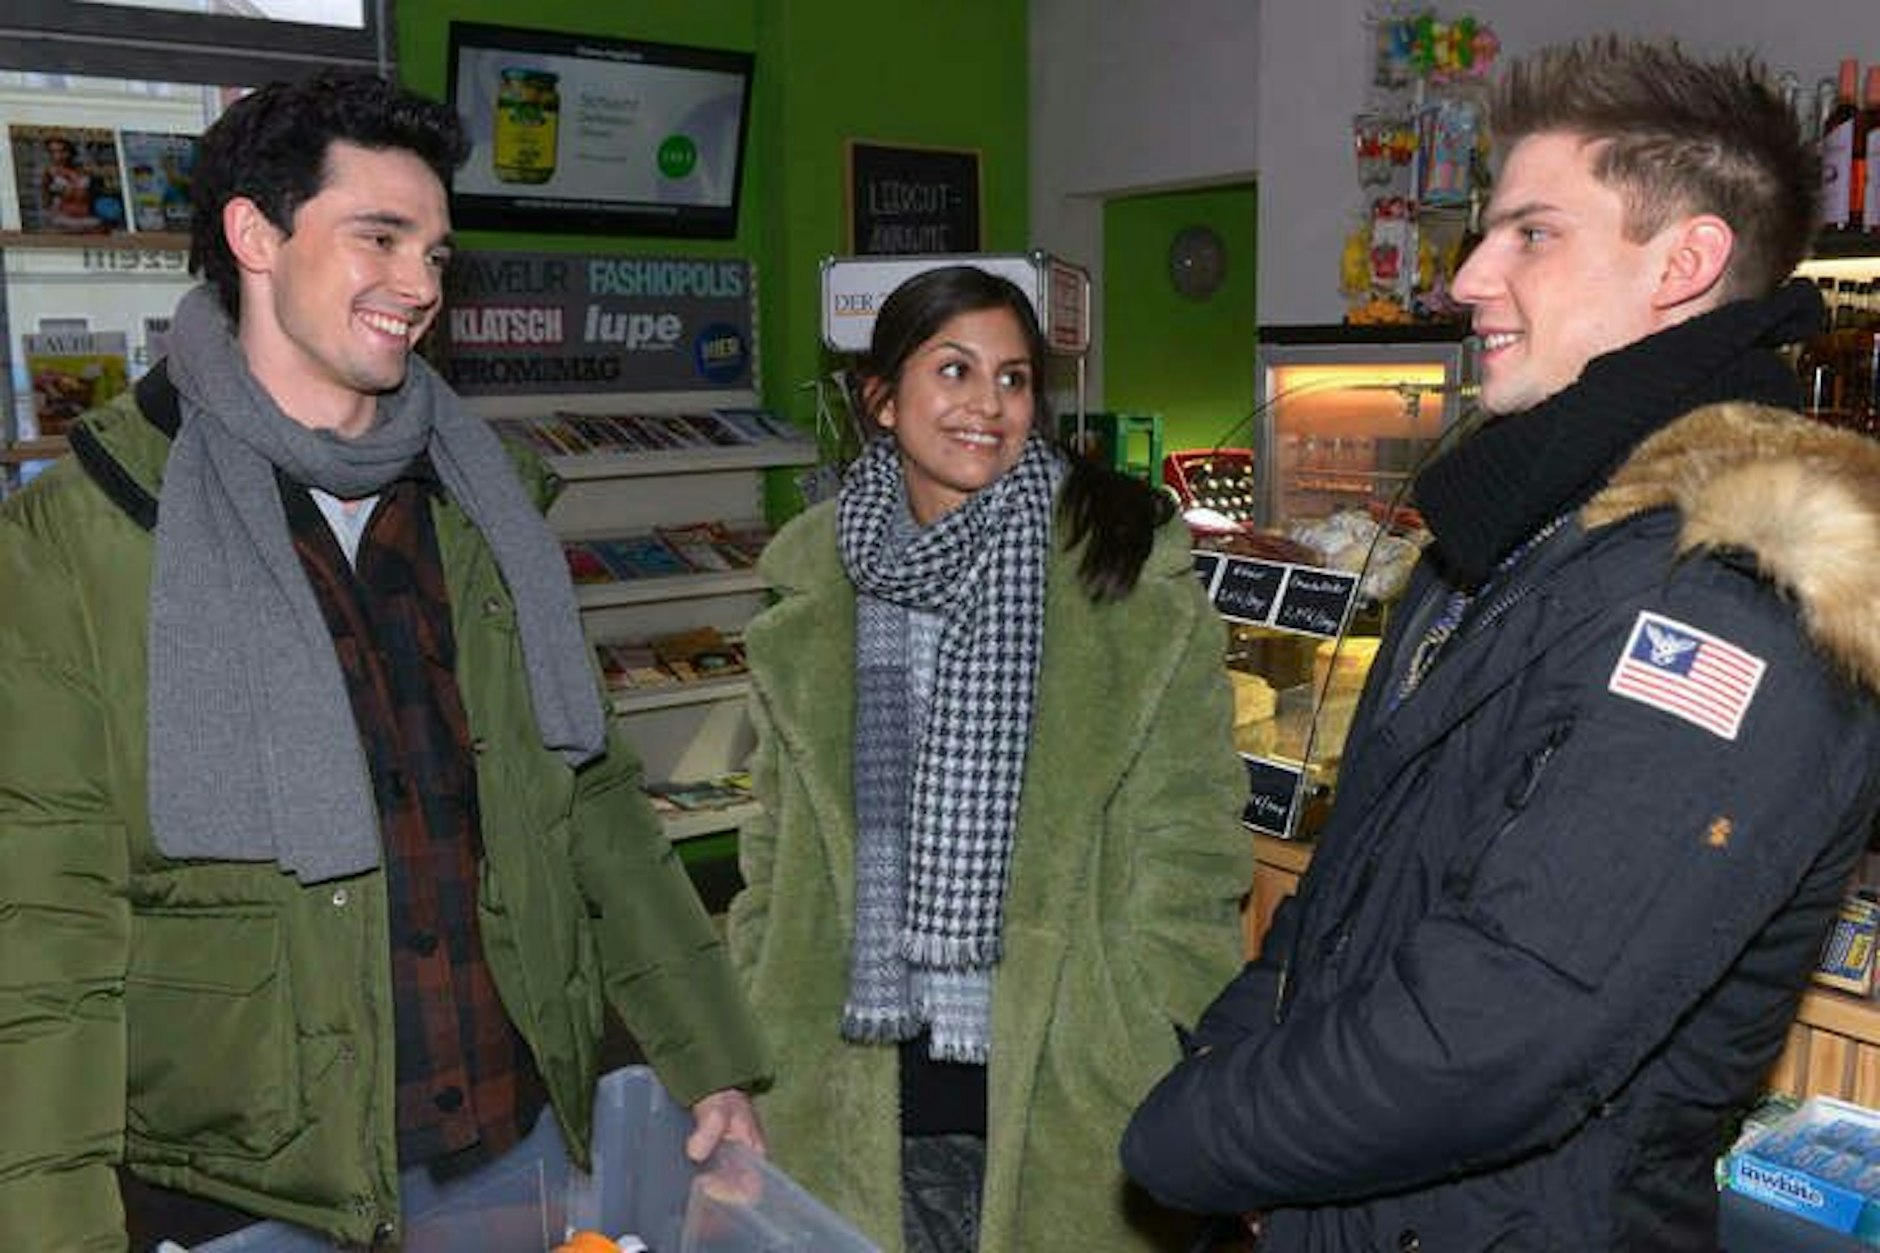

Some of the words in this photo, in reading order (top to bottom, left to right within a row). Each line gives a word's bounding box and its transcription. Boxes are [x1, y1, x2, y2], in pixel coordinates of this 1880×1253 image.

[588, 260, 744, 297] FASHIOPOLIS
[834, 293, 873, 311] DER
[449, 307, 564, 344] KLATSCH
[583, 304, 682, 350] lupe
